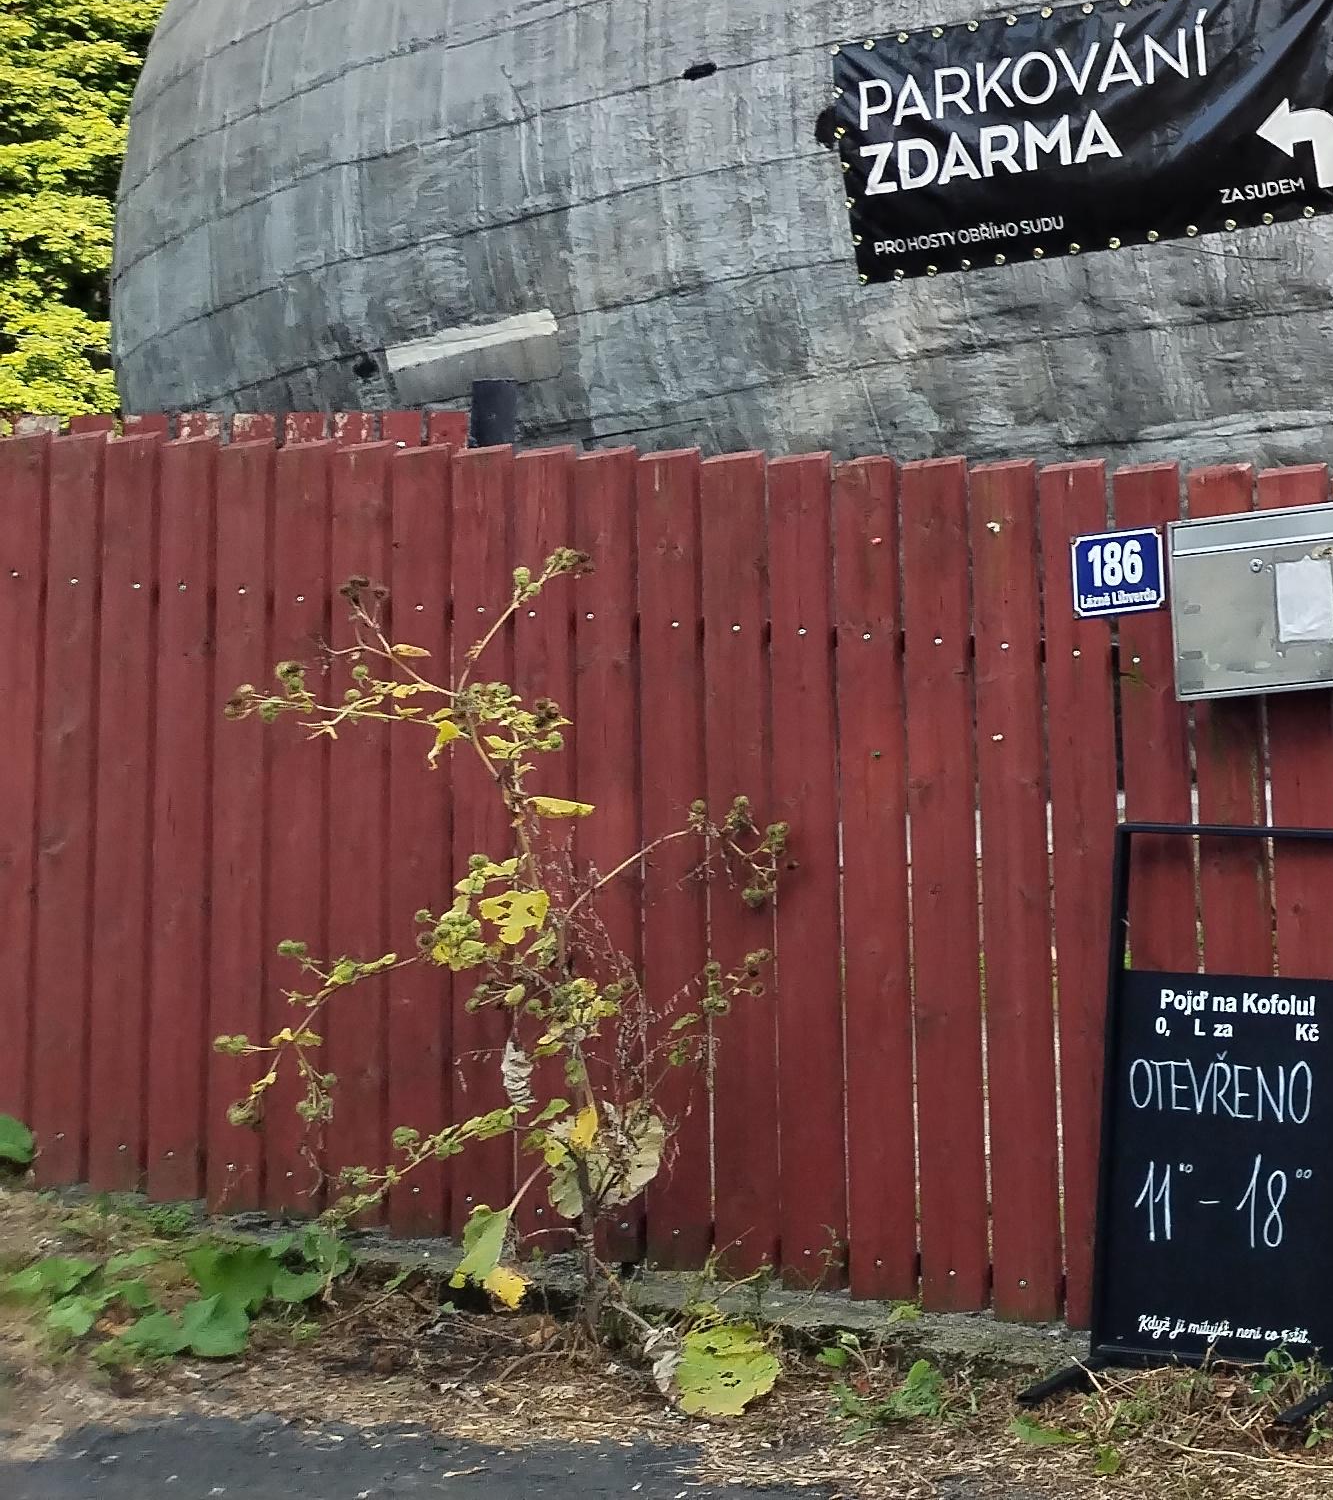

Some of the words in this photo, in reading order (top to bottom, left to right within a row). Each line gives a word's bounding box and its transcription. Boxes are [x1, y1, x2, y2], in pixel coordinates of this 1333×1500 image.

[857, 6, 1209, 132] PARKOVÁNÍ
[858, 108, 1124, 197] ZDARMA
[1218, 187, 1245, 204] ZA
[1243, 176, 1306, 200] SUDEM
[873, 238, 907, 256] PRO
[906, 230, 957, 251] HOSTY
[957, 221, 1019, 244] OBŘÍHO
[1019, 215, 1065, 235] SUDU
[1087, 539, 1143, 587] 186
[1160, 988, 1210, 1016] Pojď
[1212, 996, 1238, 1013] na
[1242, 992, 1316, 1017] Kofolu!
[1194, 1018, 1206, 1037] L
[1212, 1023, 1233, 1038] za
[1295, 1022, 1320, 1043] Kč
[1129, 1051, 1313, 1124] OTEVŘENO
